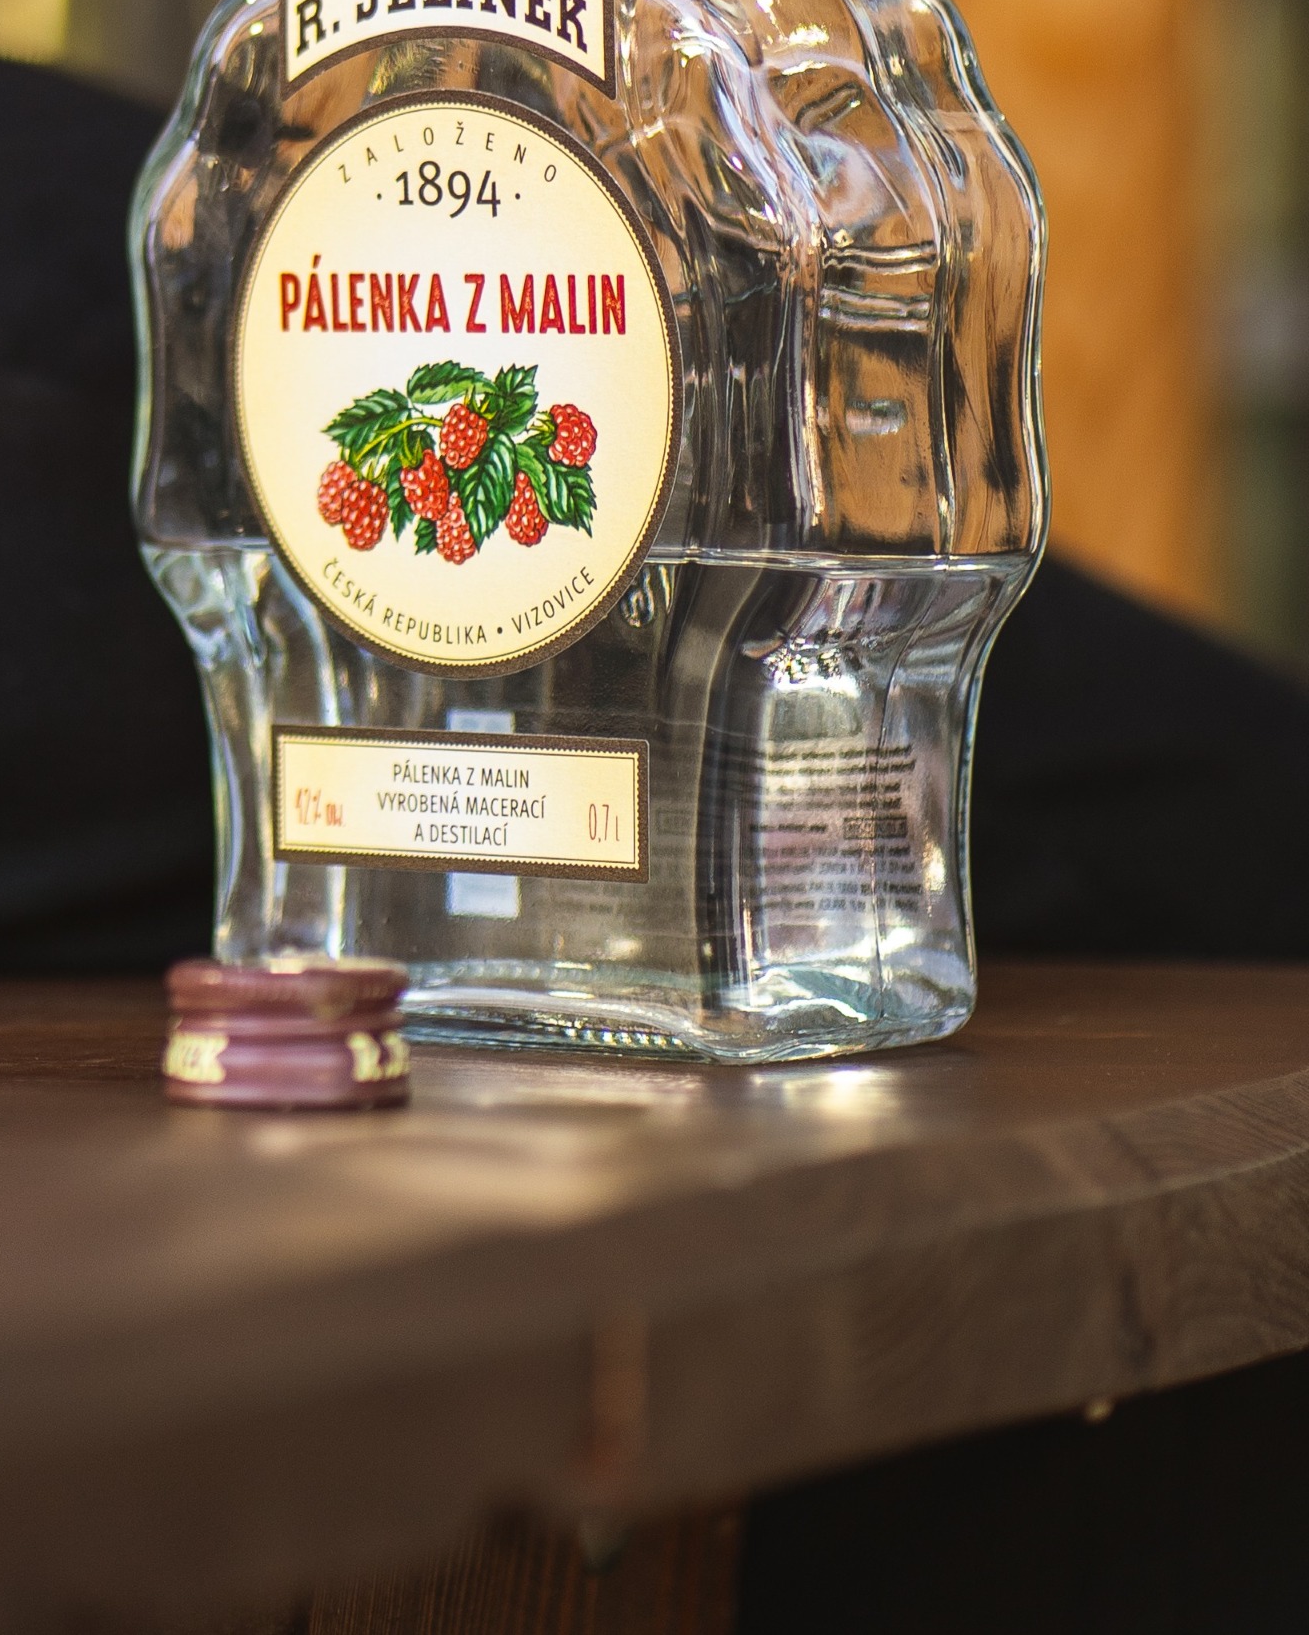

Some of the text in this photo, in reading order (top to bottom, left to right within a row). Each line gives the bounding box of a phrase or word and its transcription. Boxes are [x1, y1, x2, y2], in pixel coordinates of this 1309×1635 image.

[338, 121, 558, 184] ZALOŽENO
[280, 254, 627, 335] PÁLENKA Z MALIN
[323, 557, 596, 645] ČESKÁ REPUBLIKA VIZOVICE
[393, 762, 530, 789] PÁLENKA Z MALIN
[378, 791, 546, 820] VYROBENÁ MACERACÍ
[588, 803, 610, 843] 0,7
[414, 823, 508, 847] A DESTILACÍ
